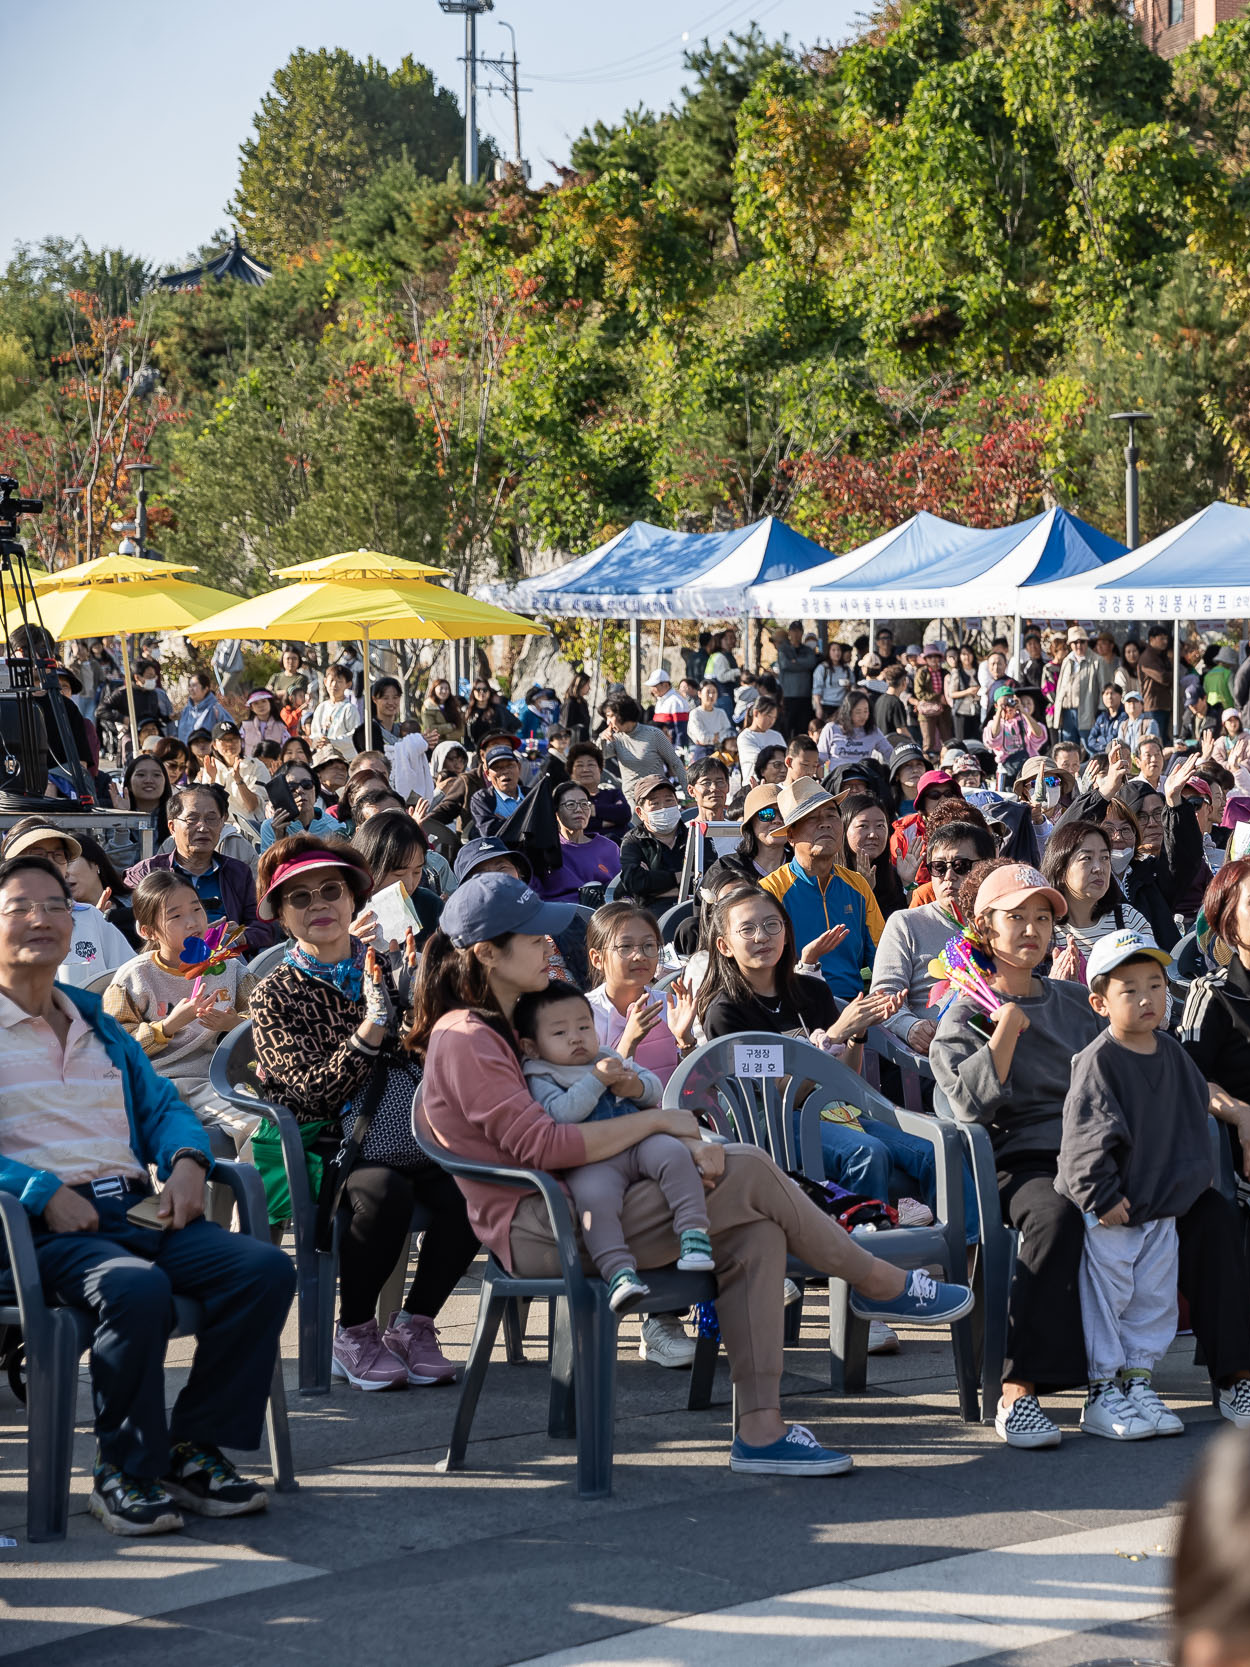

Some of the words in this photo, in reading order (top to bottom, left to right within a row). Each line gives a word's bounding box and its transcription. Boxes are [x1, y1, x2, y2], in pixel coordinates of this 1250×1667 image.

[801, 598, 832, 614] 광장동
[1098, 595, 1135, 613] 광장동
[1144, 594, 1226, 613] 자원봉사캠프
[1117, 934, 1144, 947] NIKE
[746, 1049, 770, 1059] 구청장
